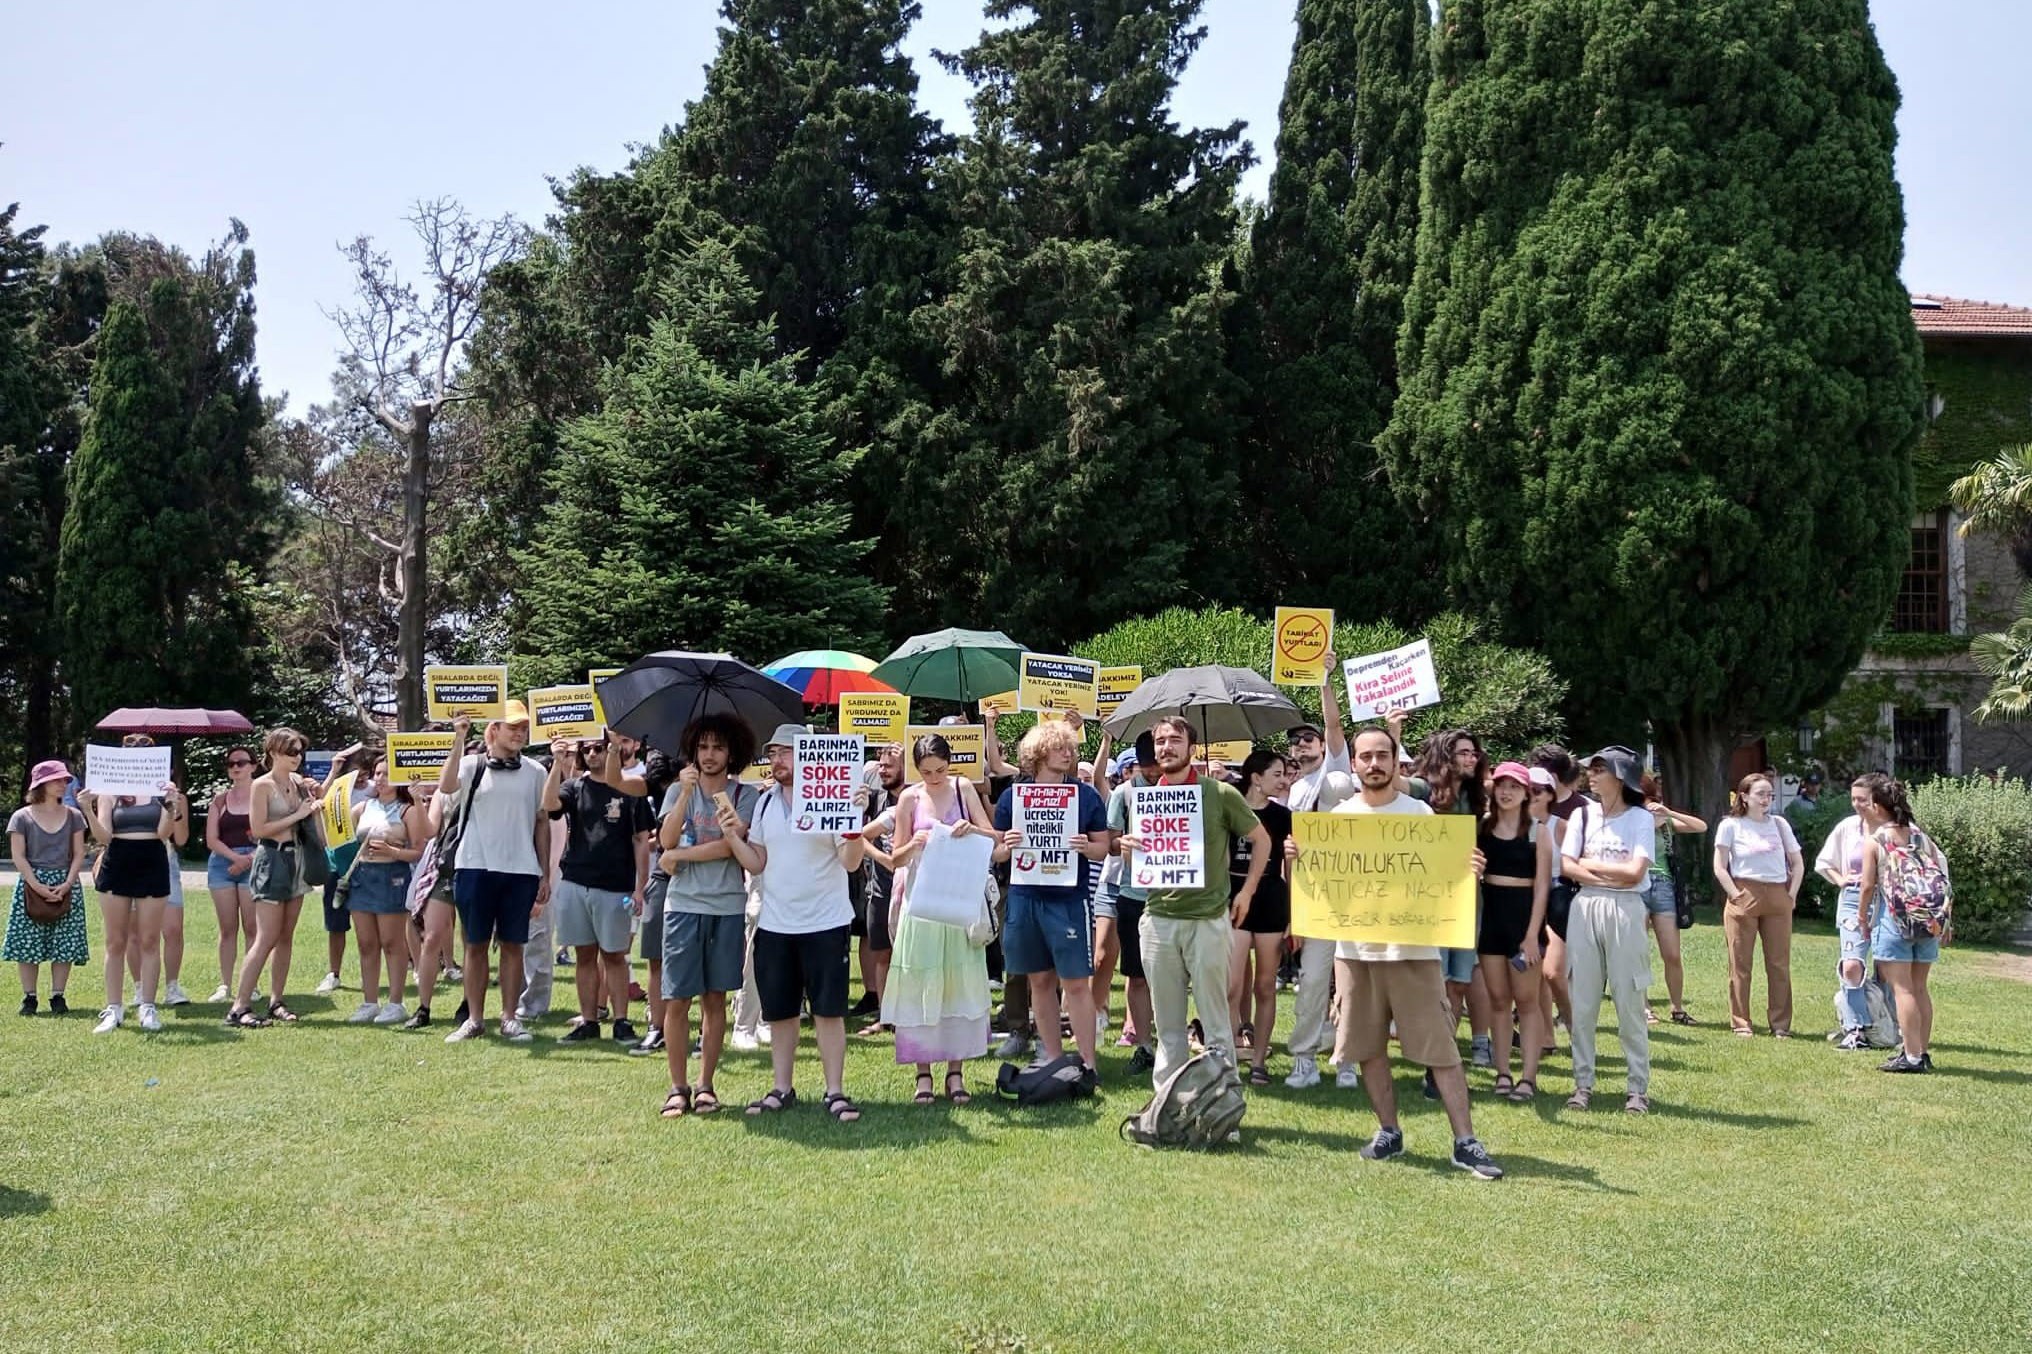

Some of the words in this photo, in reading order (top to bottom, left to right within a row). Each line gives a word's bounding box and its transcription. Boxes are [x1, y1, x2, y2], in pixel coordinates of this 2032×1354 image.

[1028, 660, 1063, 670] YATACAK
[1347, 654, 1398, 676] Depremden
[1388, 649, 1426, 671] Kaçarken
[1048, 671, 1073, 679] YOKSA
[1028, 679, 1062, 688] YATACAK
[1355, 679, 1380, 693] Kira
[574, 692, 592, 700] DEĞİ
[1391, 693, 1419, 708] MFT
[800, 740, 858, 750] BARINMA
[799, 751, 860, 762] HAKKIMIZ
[802, 762, 851, 781] SÖKE
[802, 780, 851, 799] SÖKE
[1137, 790, 1196, 802] BARINMA
[805, 802, 850, 812] ALIRIZ!
[1137, 802, 1199, 814] HAKKIMIZ
[1025, 808, 1065, 821] ücretsiz
[821, 816, 857, 831] MFT
[1027, 821, 1064, 834] nitelikli
[1141, 814, 1190, 833] SÖKE
[1302, 818, 1359, 843] YURT
[1378, 818, 1451, 844] YOKSA
[1028, 835, 1062, 848] YURT!
[1142, 834, 1190, 852] SÖKE
[1041, 850, 1069, 863] MFT
[1145, 854, 1191, 866] ALIRIZ!
[1296, 850, 1428, 875] KAYYUMLUKTA
[1161, 870, 1199, 884] MFT
[1309, 879, 1389, 901] YATICAZ
